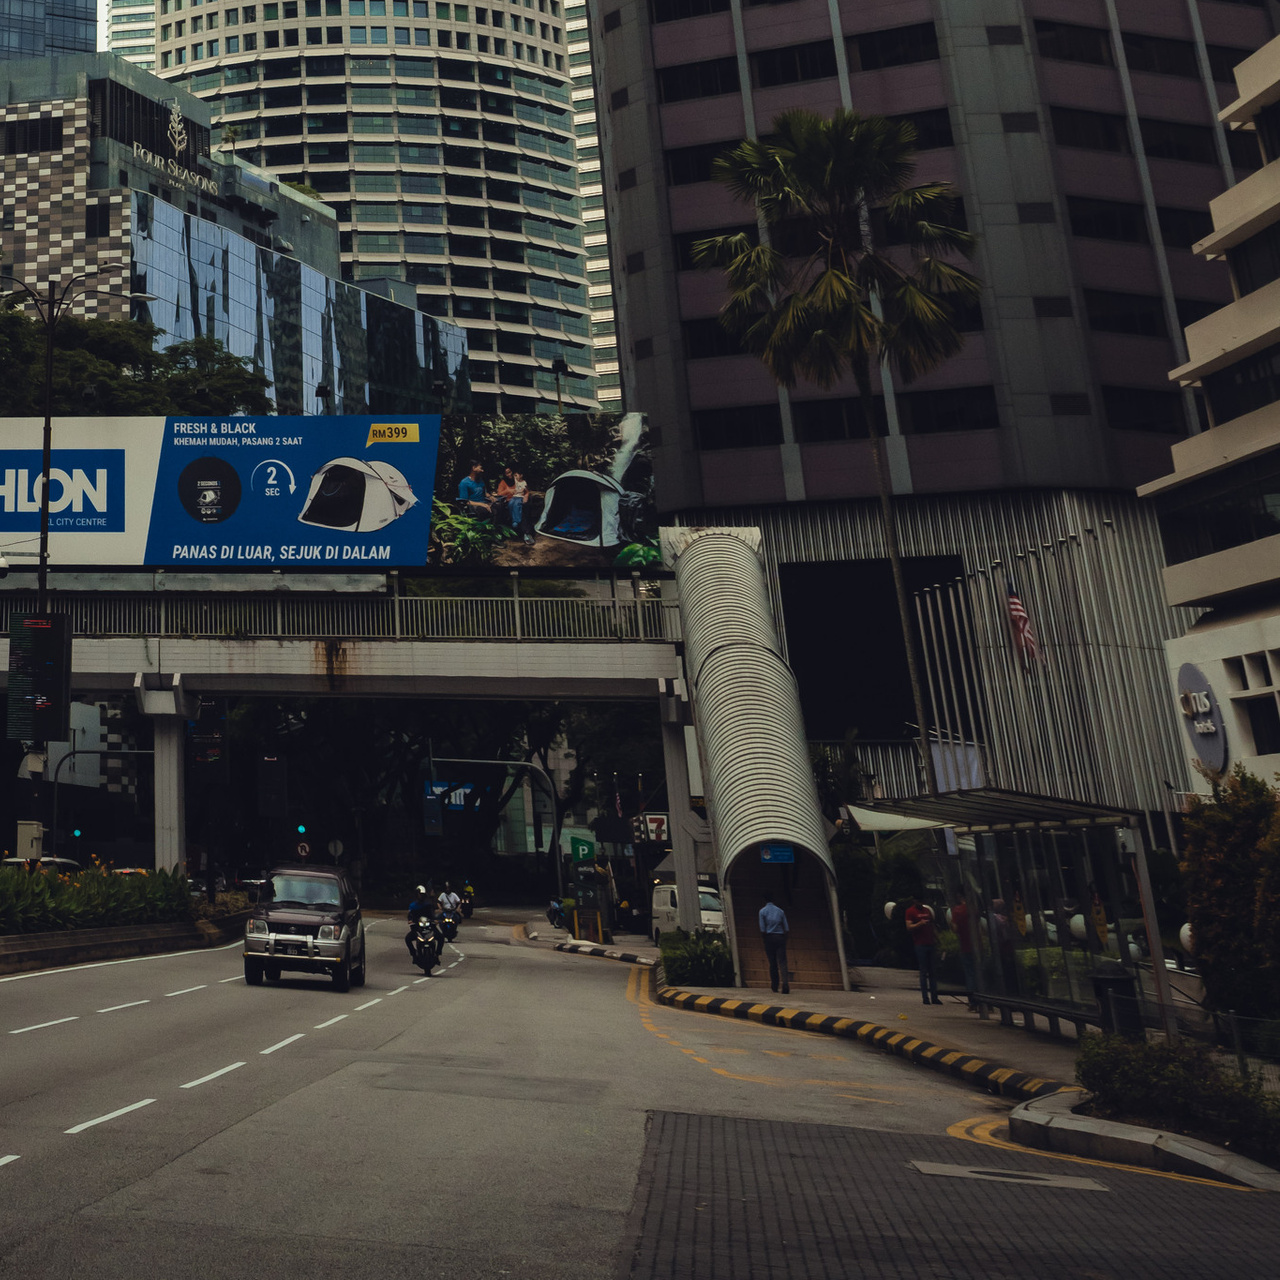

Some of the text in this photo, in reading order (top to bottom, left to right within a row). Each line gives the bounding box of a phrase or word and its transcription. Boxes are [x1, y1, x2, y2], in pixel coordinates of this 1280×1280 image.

[133, 141, 218, 196] FOUR SEASONS
[173, 423, 257, 434] FRESH & BLACK
[372, 427, 408, 438] RM399
[173, 436, 303, 447] KHEMAH MUDAH, PASANG 2 SAAT
[267, 466, 278, 485] 2
[265, 487, 280, 496] SEC
[56, 518, 74, 526] CITY
[75, 518, 107, 526] CENTRE
[172, 545, 391, 562] PANAS DI LUAR, SEJUK DI DALAM
[648, 817, 665, 840] 7
[578, 845, 589, 859] P
